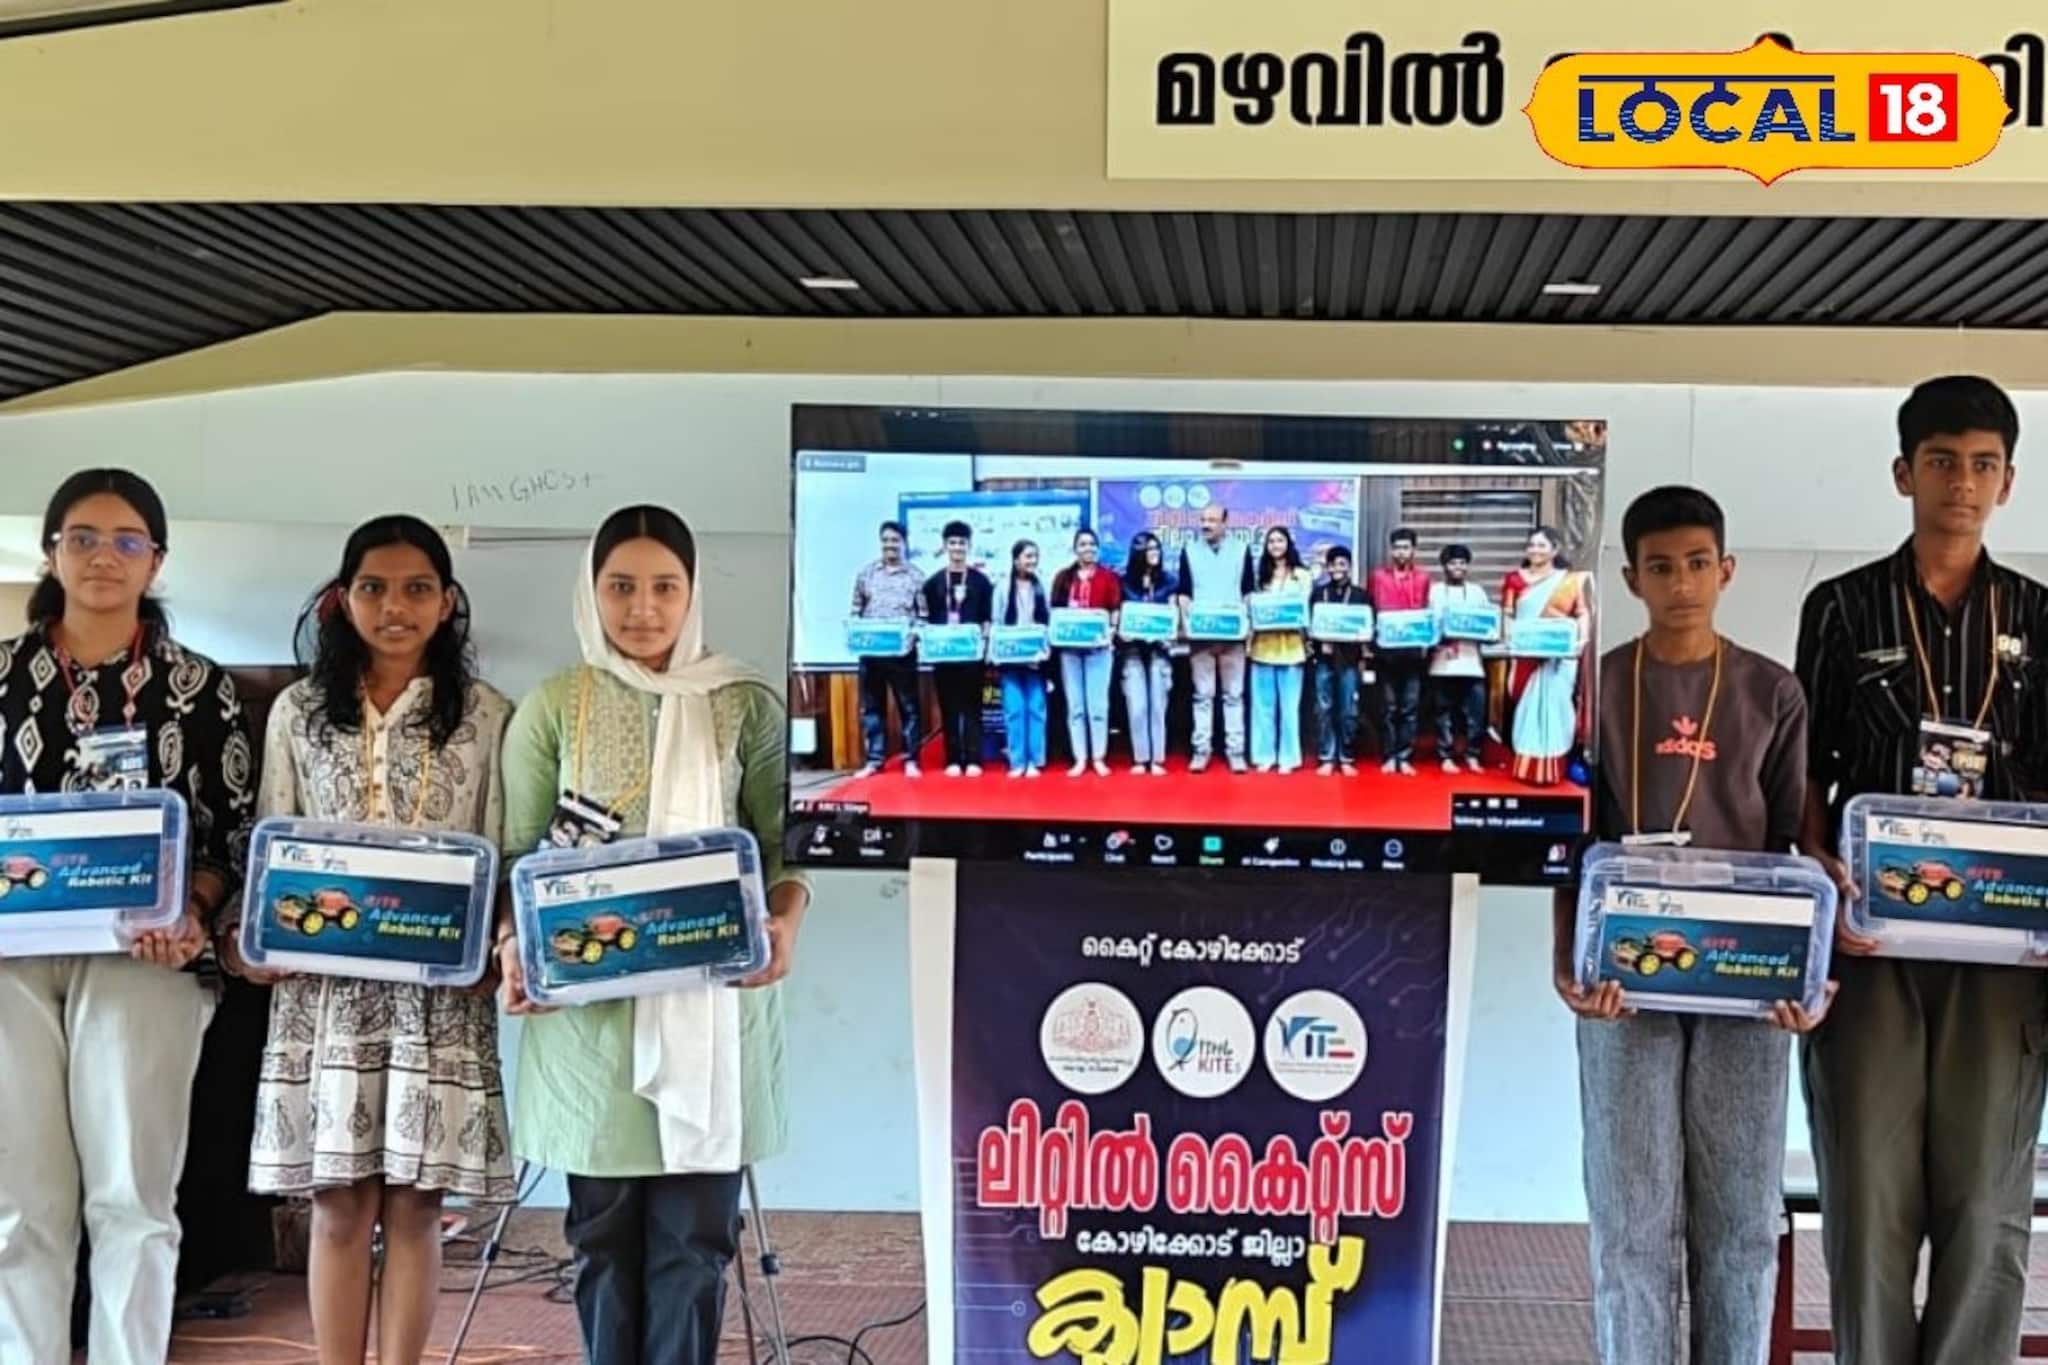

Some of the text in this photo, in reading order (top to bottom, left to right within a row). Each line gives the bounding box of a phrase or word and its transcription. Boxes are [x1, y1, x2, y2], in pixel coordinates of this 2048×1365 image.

[1156, 32, 1504, 127] മഴവിൽ
[58, 861, 142, 878] Advanced
[67, 872, 154, 889] Robotic Kit
[368, 908, 453, 926] Advanced
[645, 911, 728, 936] Advanced
[377, 920, 462, 940] Robotic Kit
[656, 922, 740, 947] Robotic Kit
[1160, 936, 1304, 964] കോഴിക്കോട്
[1706, 950, 1789, 966] Advanced
[1714, 961, 1800, 978] Robotic Kit
[977, 1098, 1160, 1240] ലിറ്റിൽ
[1076, 1228, 1305, 1268] കോഴിക്കോട് ജില്ലാ
